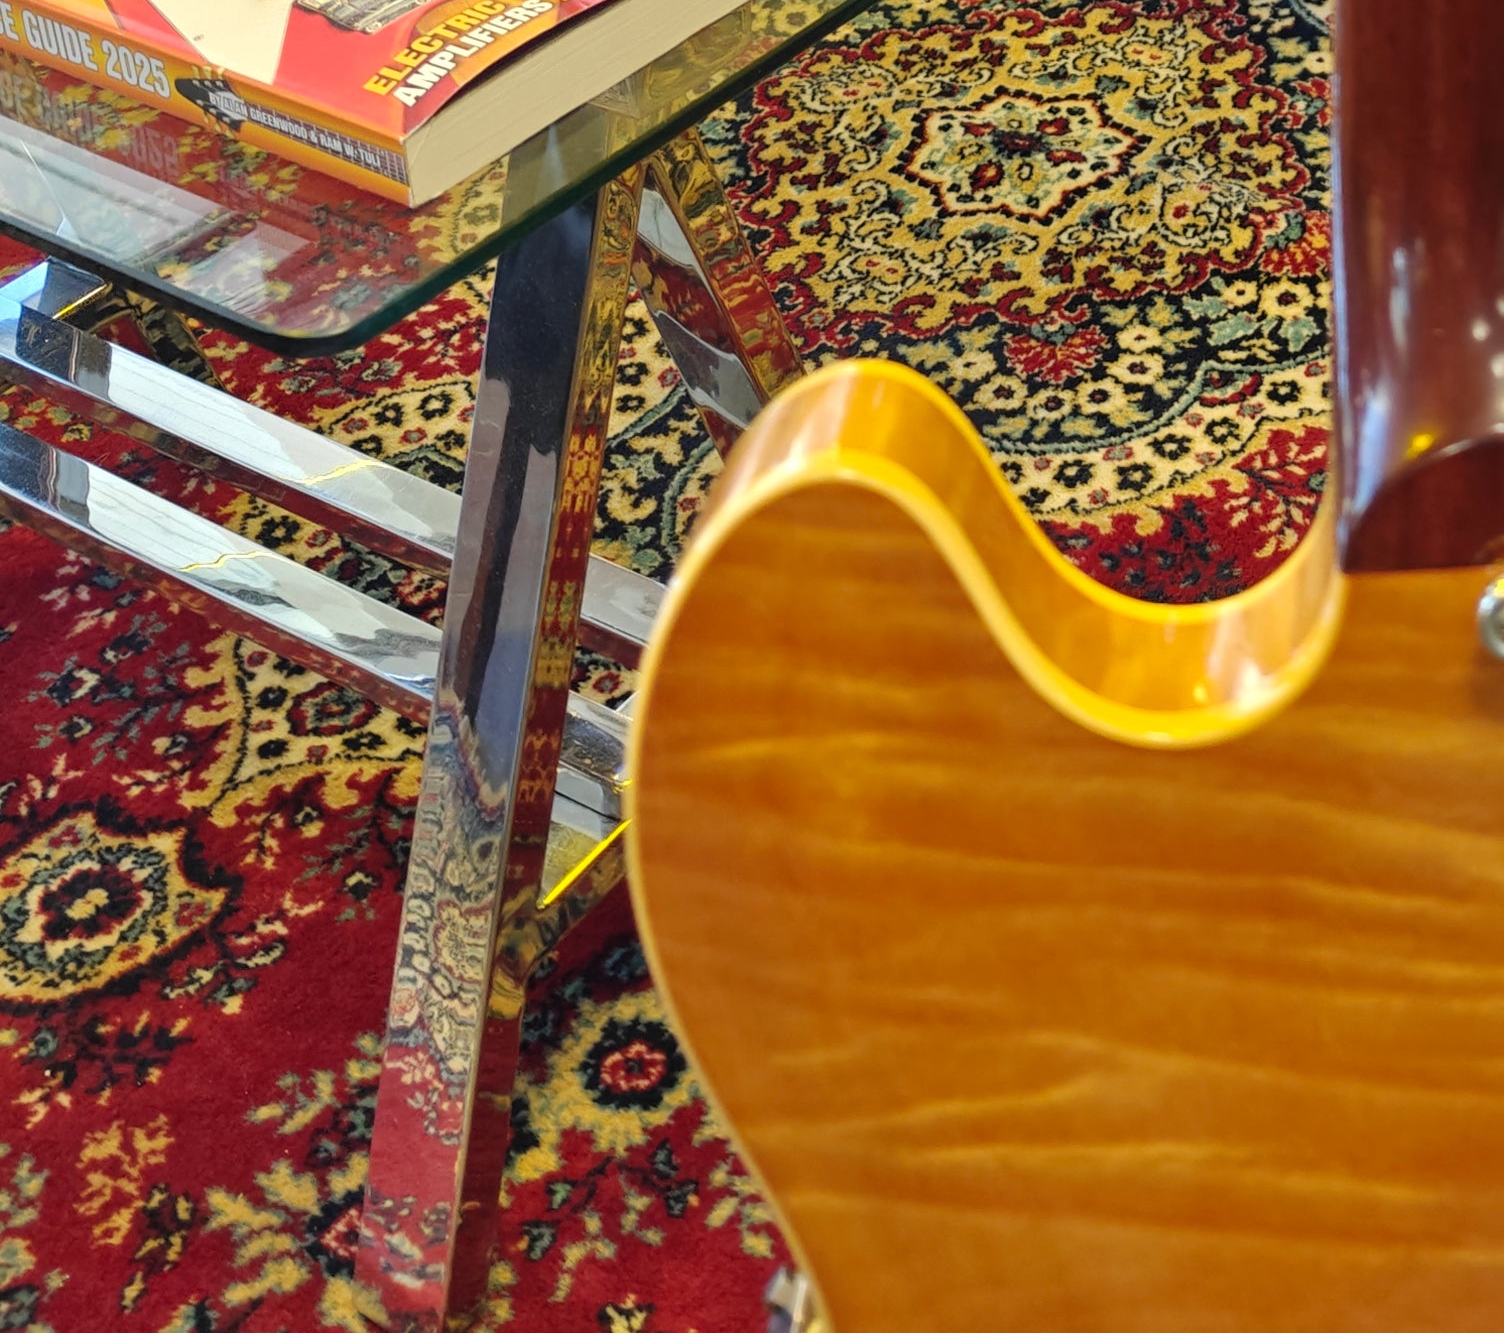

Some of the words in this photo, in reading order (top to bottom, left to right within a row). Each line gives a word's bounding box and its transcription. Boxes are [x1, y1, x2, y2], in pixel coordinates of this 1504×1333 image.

[21, 9, 99, 72] GUIDE
[101, 39, 171, 99] 2025
[363, 0, 506, 96] ELECTRIC
[223, 95, 247, 117] ALAN
[249, 107, 309, 140] GREENWOOD
[310, 131, 318, 143] &
[320, 133, 343, 153] RAM
[359, 148, 382, 168] TULI
